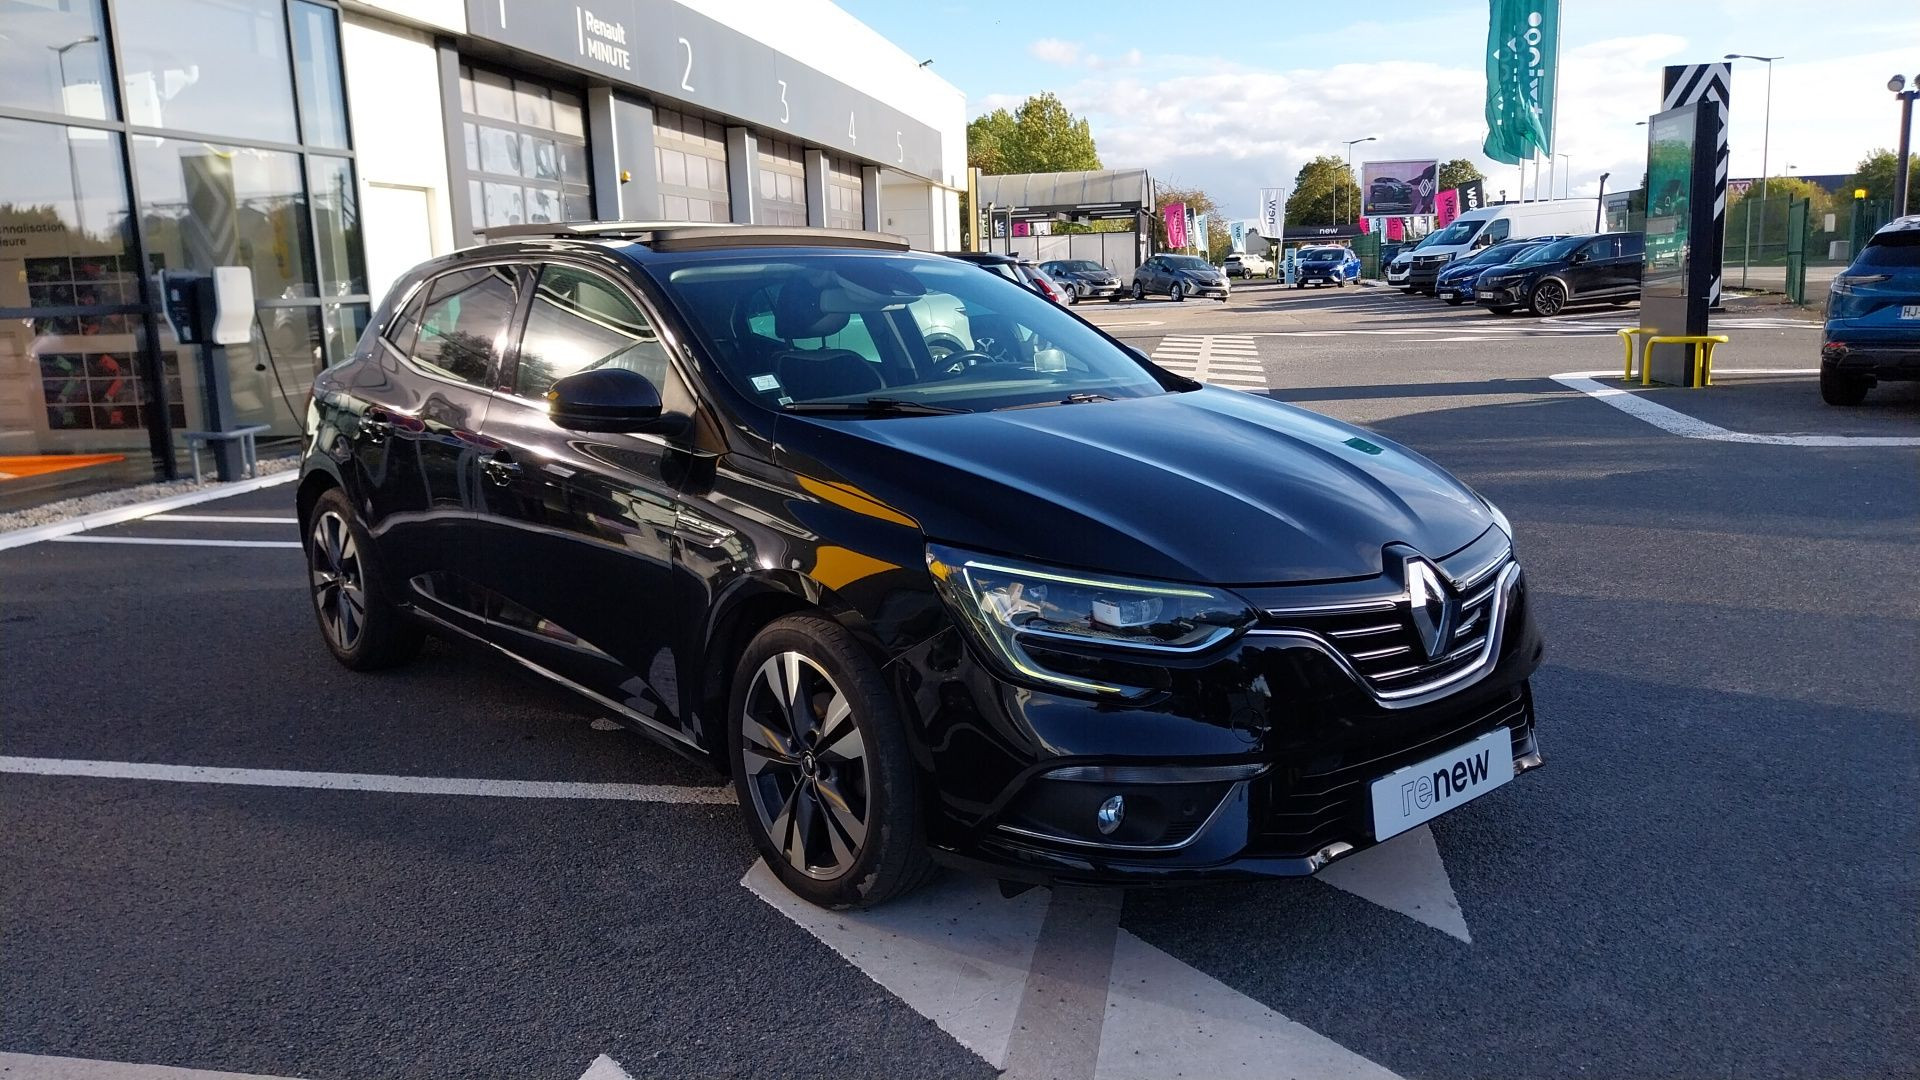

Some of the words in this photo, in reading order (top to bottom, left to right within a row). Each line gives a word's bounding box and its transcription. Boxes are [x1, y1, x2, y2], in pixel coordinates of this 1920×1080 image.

[584, 10, 627, 45] Renault
[586, 38, 631, 71] MINUTE
[678, 37, 695, 92] 2
[778, 79, 789, 124] 3
[848, 111, 857, 147] 4
[896, 131, 903, 163] 5
[1319, 227, 1338, 235] new
[1401, 749, 1490, 817] renew
